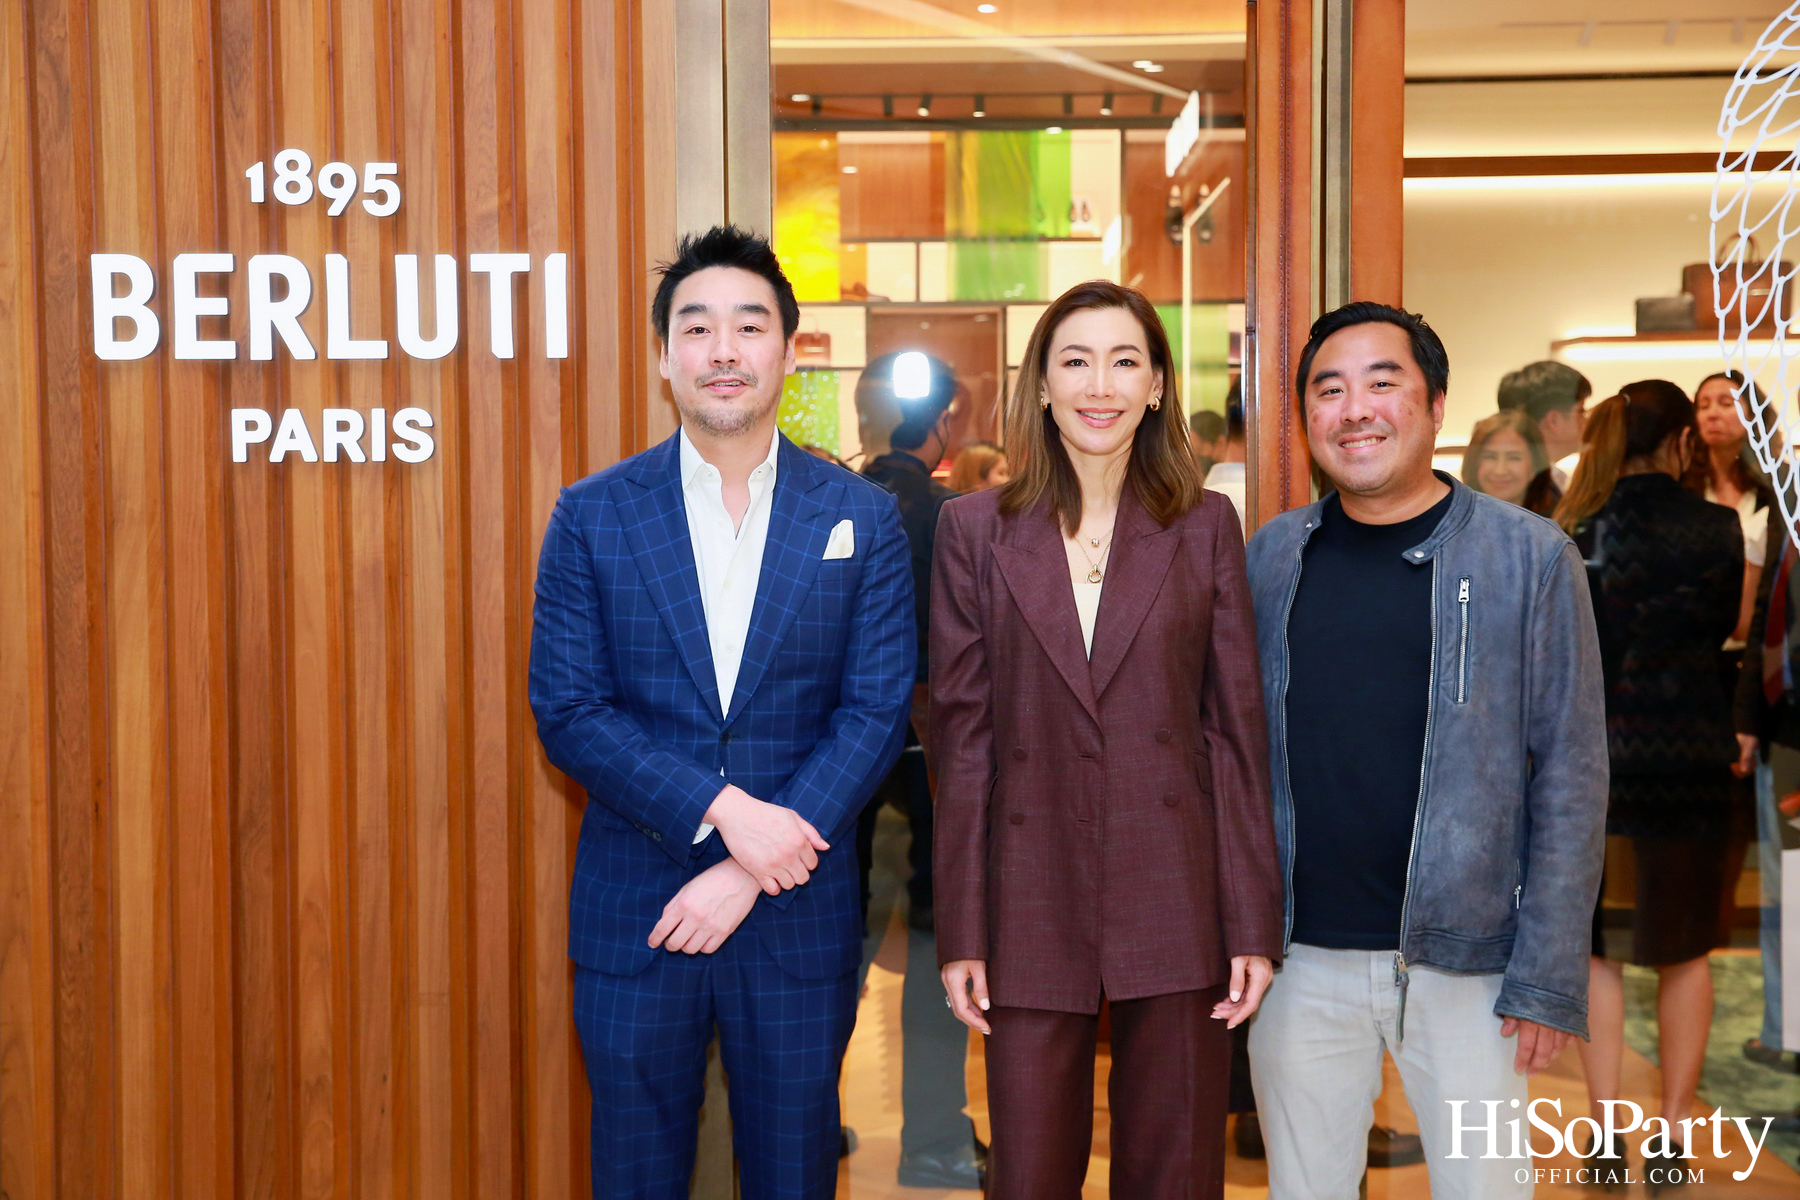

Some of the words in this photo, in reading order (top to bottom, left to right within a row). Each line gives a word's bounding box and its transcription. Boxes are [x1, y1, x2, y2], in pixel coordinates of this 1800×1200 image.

[245, 148, 401, 217] 1895
[90, 252, 568, 361] BERLUTI
[231, 407, 435, 463] PARIS
